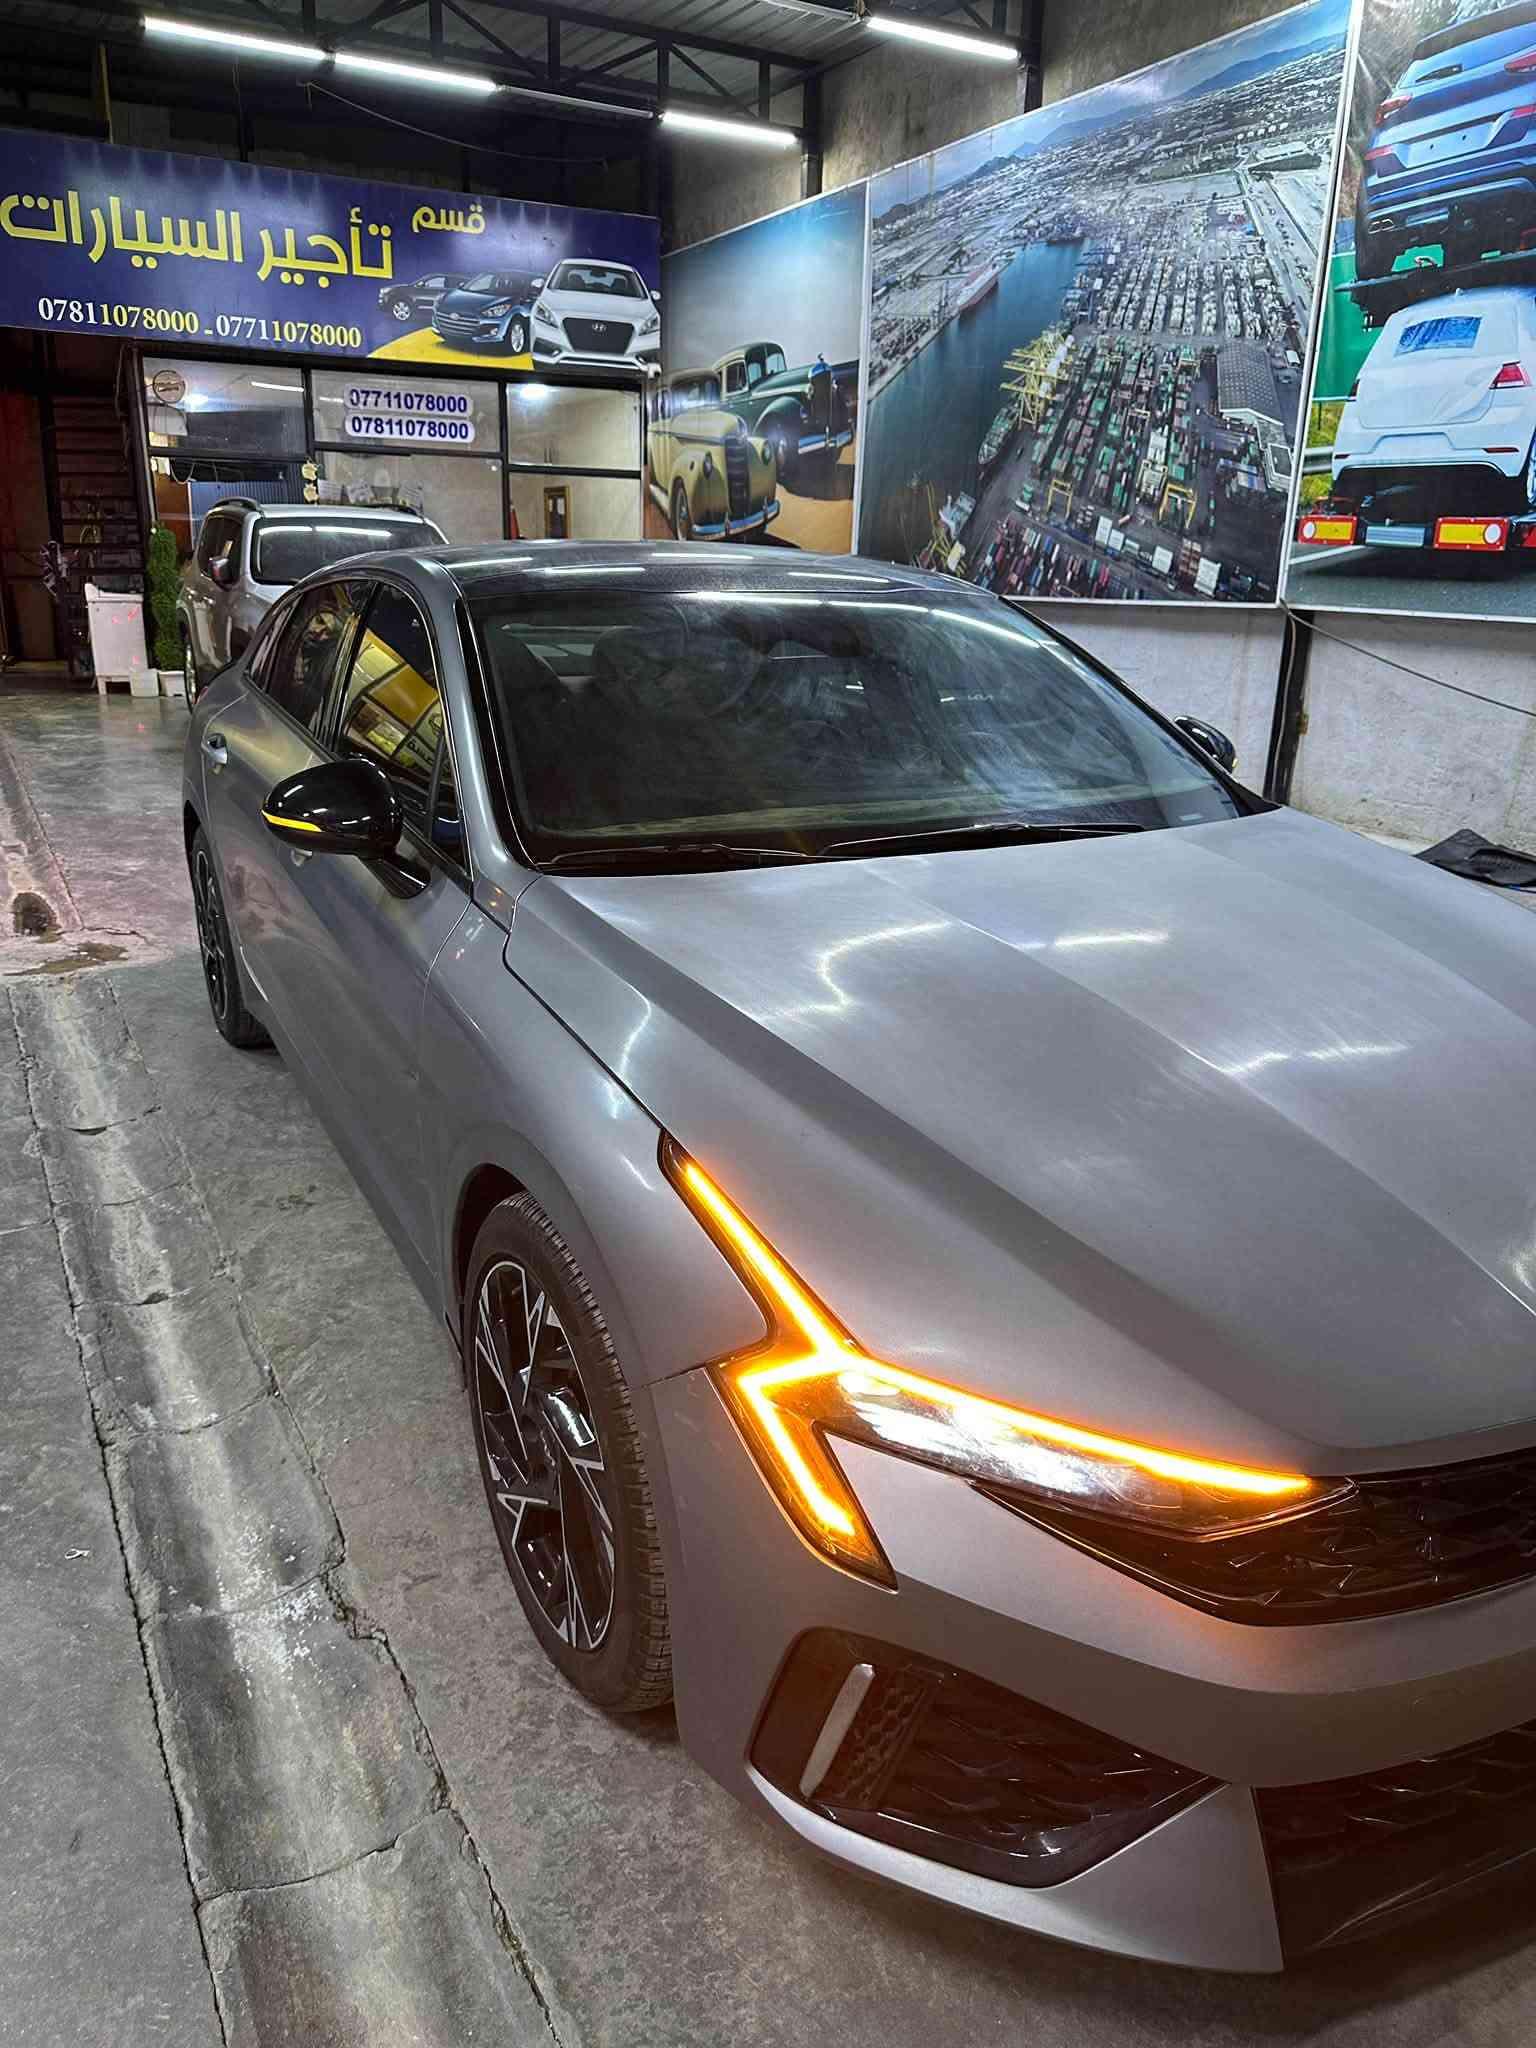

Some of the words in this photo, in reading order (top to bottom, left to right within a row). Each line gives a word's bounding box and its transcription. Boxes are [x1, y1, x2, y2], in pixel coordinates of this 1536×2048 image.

[0, 190, 244, 269] السيارات
[412, 204, 486, 235] قسم
[257, 206, 393, 288] تأجير
[38, 297, 199, 334] 07811078000
[216, 314, 362, 348] 07711078000
[350, 388, 467, 413] 07711078000
[352, 416, 469, 439] 07811078000
